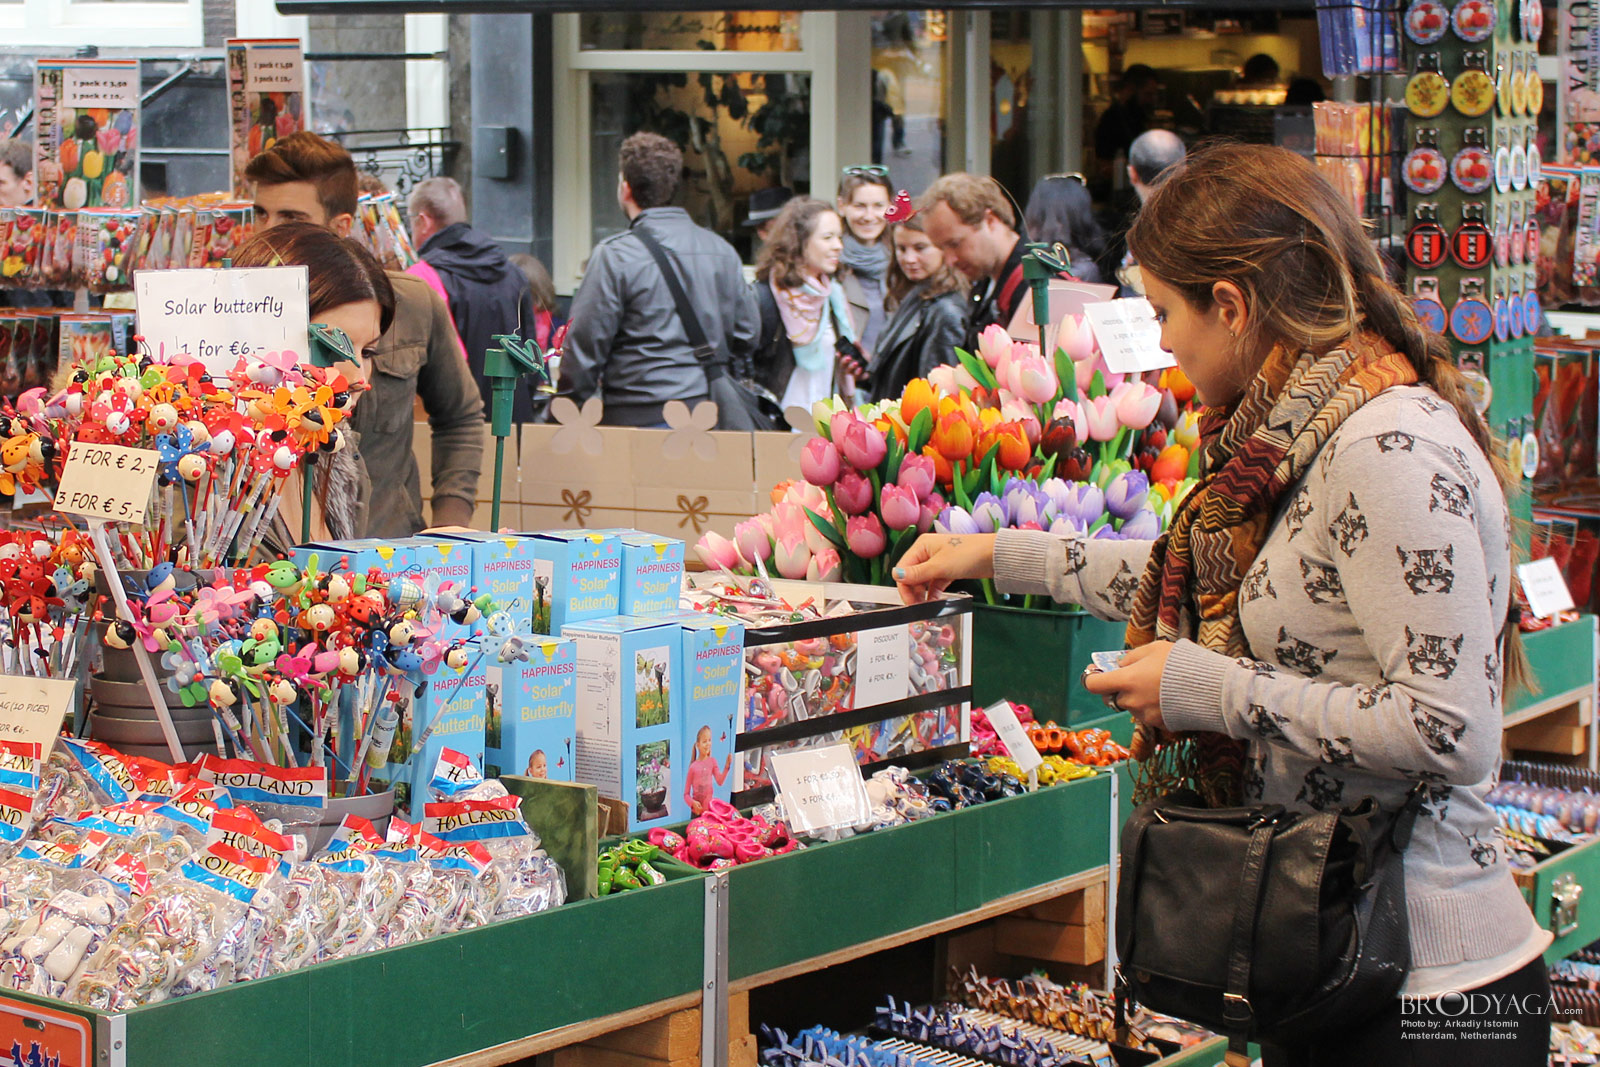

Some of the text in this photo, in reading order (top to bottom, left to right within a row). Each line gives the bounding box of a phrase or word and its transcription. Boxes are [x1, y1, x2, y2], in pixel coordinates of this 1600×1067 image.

[79, 80, 100, 88] pack
[38, 90, 57, 162] TULIPA
[164, 295, 284, 318] Solar butterfly
[198, 339, 223, 357] for
[69, 448, 155, 475] 1 FOR € 2,-
[56, 491, 143, 519] 3 FOR € 5,-
[484, 559, 532, 572] HAPPINESS
[571, 558, 620, 572] HAPPINESS
[636, 562, 681, 575] HAPPINESS
[491, 578, 521, 594] Solar
[579, 577, 609, 592] Solar
[642, 581, 670, 595] Solar
[569, 593, 619, 612] Butterfly
[633, 599, 677, 613] Butterfly
[563, 631, 586, 639] Happiness
[696, 644, 741, 661] HAPPINESS
[521, 662, 574, 679] HAPPINESS
[703, 665, 731, 680] Solar
[531, 685, 563, 700] Solar
[693, 681, 738, 700] Butterfly
[520, 701, 574, 721] Butterfly
[213, 772, 314, 796] HOLLAND
[803, 774, 819, 784] FOR
[802, 797, 808, 805] 3
[809, 794, 825, 804] FOR
